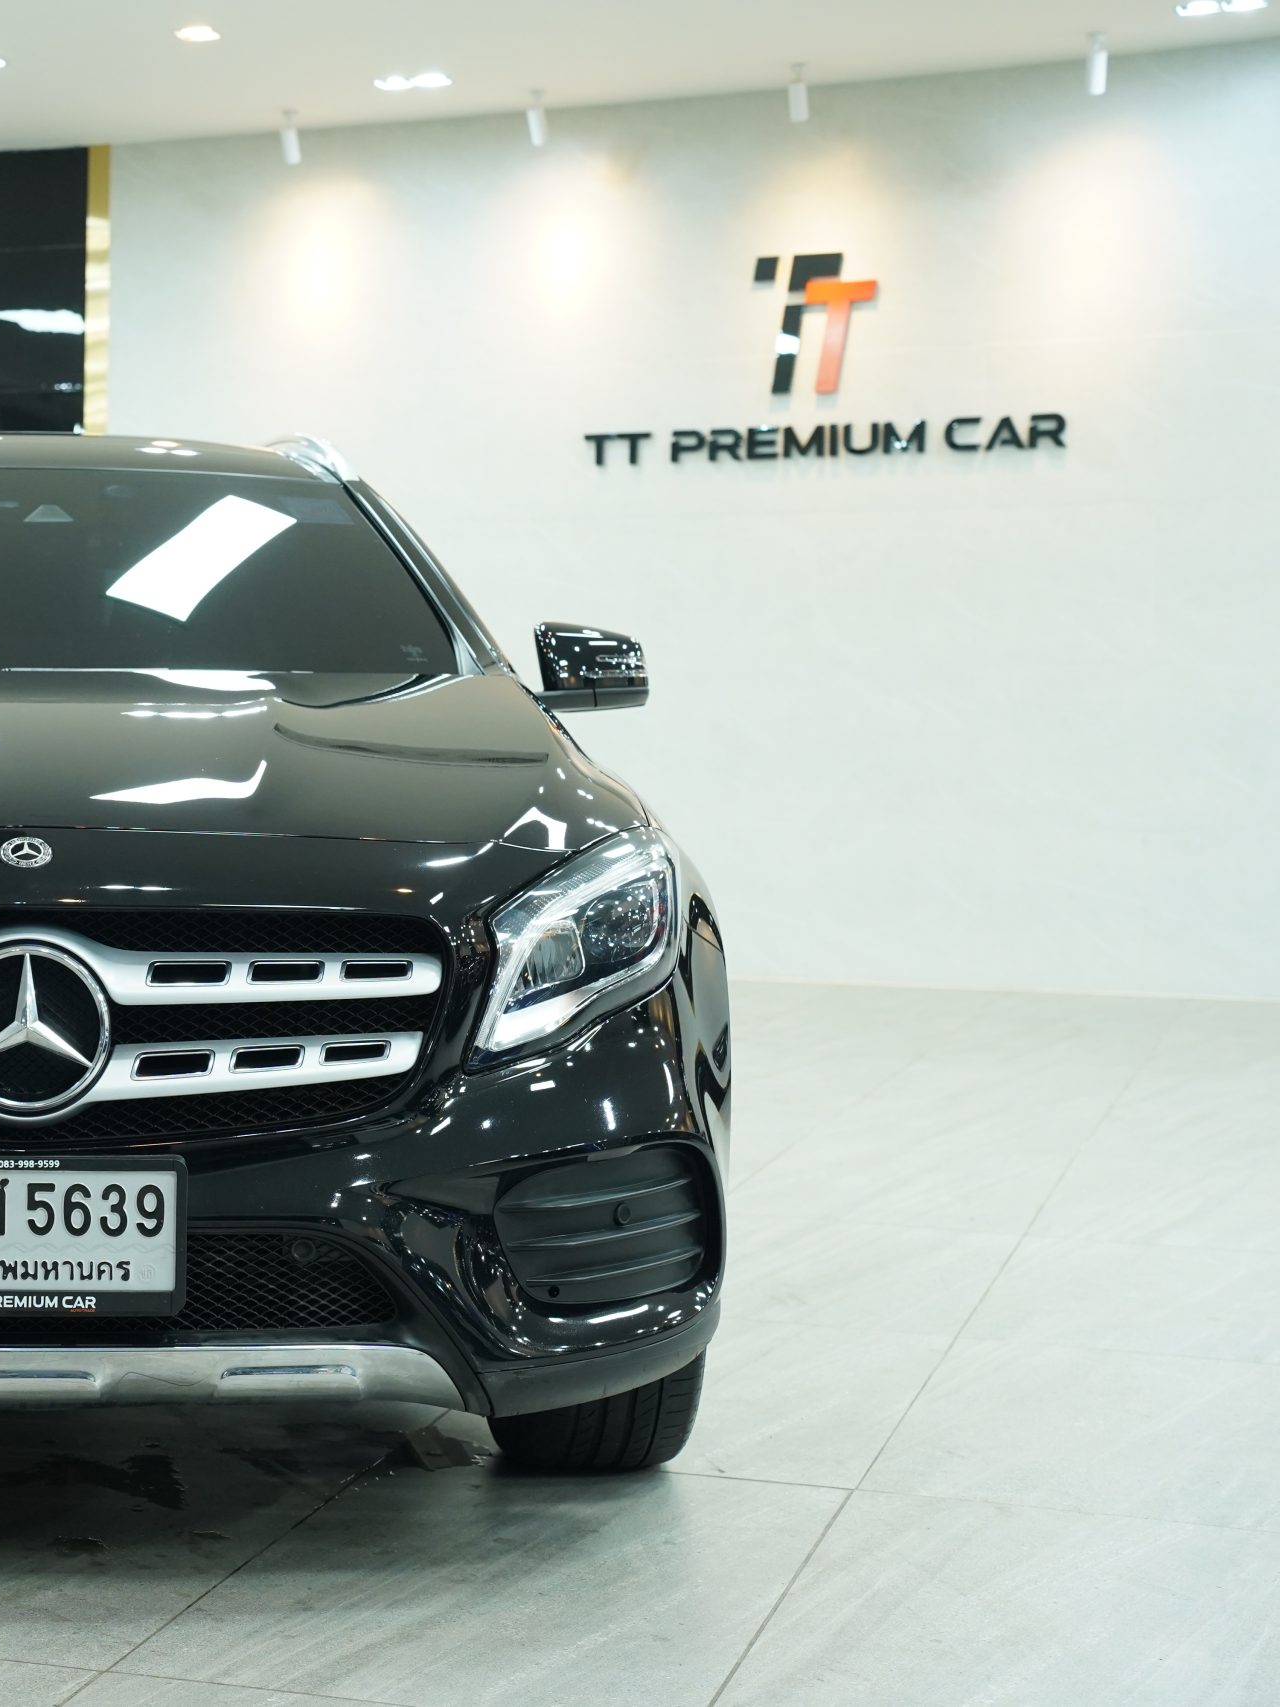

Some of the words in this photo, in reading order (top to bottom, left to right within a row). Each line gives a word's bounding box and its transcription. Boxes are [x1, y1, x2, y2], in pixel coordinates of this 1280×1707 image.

[584, 432, 652, 465] TT
[670, 420, 926, 463] PREMIUM
[944, 414, 1066, 452] CAR
[26, 1182, 165, 1238] 5639
[61, 1296, 97, 1309] CAR
